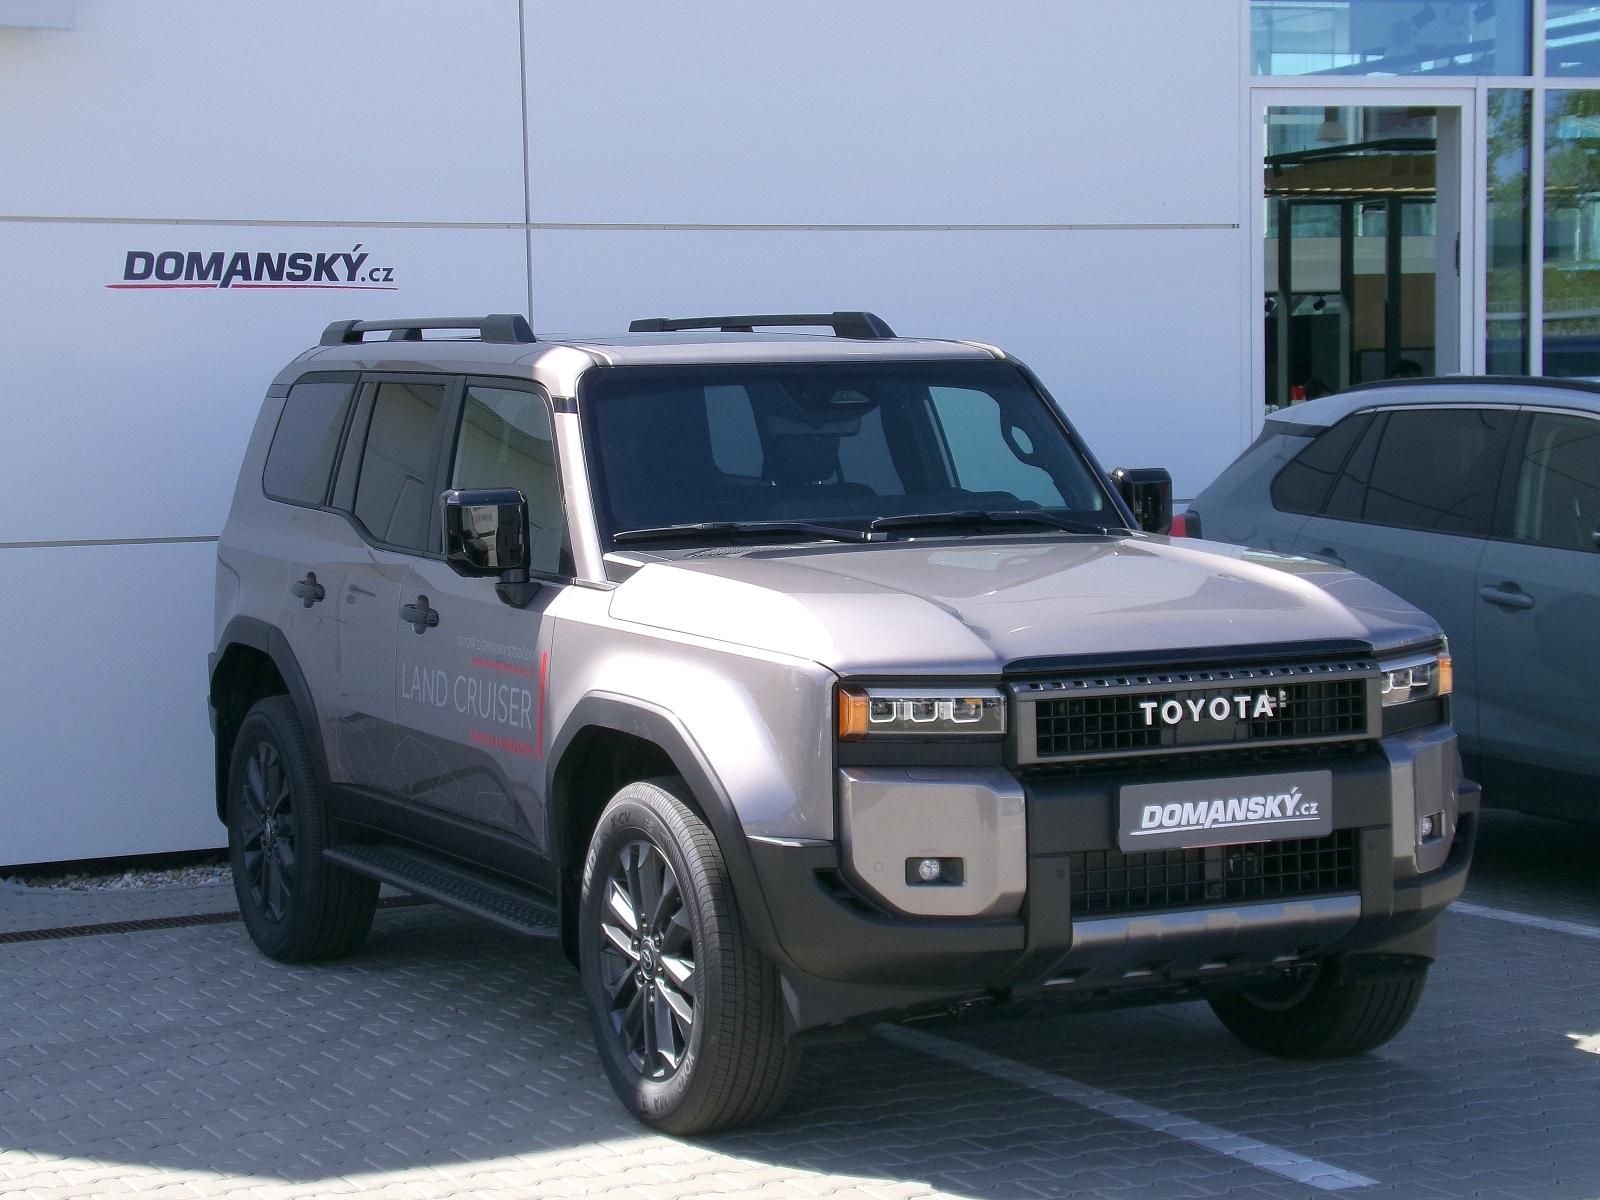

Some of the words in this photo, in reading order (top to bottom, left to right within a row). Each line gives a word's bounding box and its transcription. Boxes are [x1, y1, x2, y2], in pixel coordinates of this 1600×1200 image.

[402, 663, 448, 707] LAND
[454, 675, 533, 730] CRUISER
[1140, 694, 1274, 726] TOYOTA
